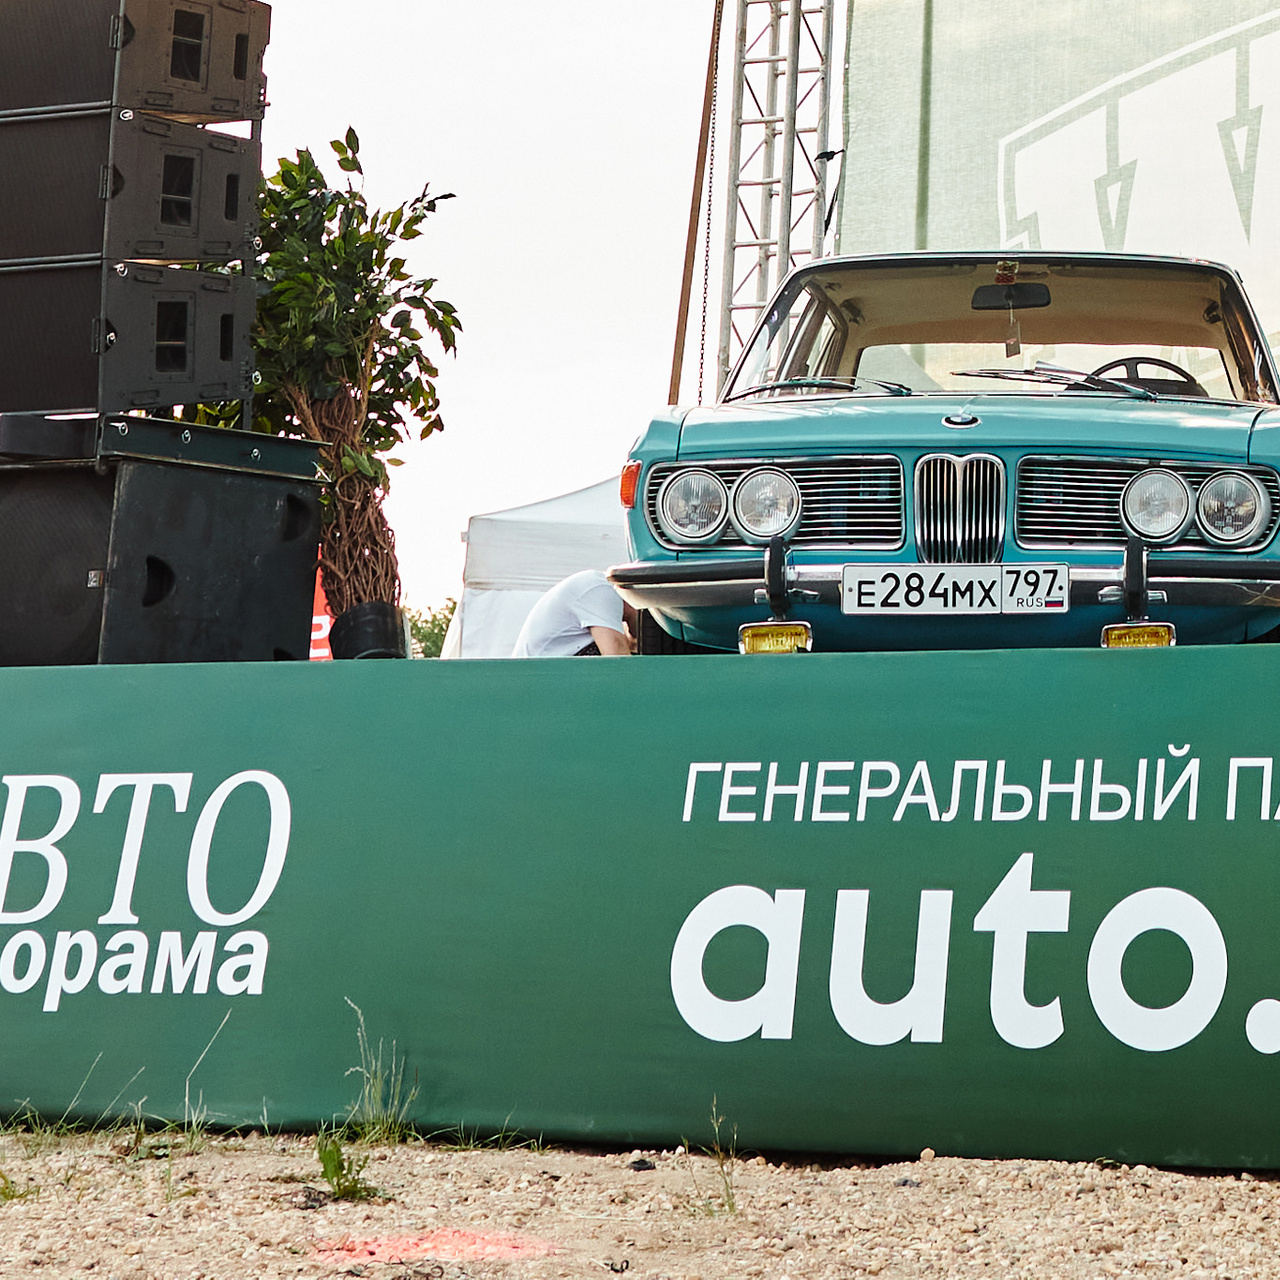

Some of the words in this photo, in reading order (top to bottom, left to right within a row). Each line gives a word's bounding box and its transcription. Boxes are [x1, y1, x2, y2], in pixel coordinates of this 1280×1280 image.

[1005, 569, 1059, 597] 797
[1016, 597, 1044, 607] RUS
[683, 743, 1201, 822] ГЕНЕРАЛЬНЫЙ
